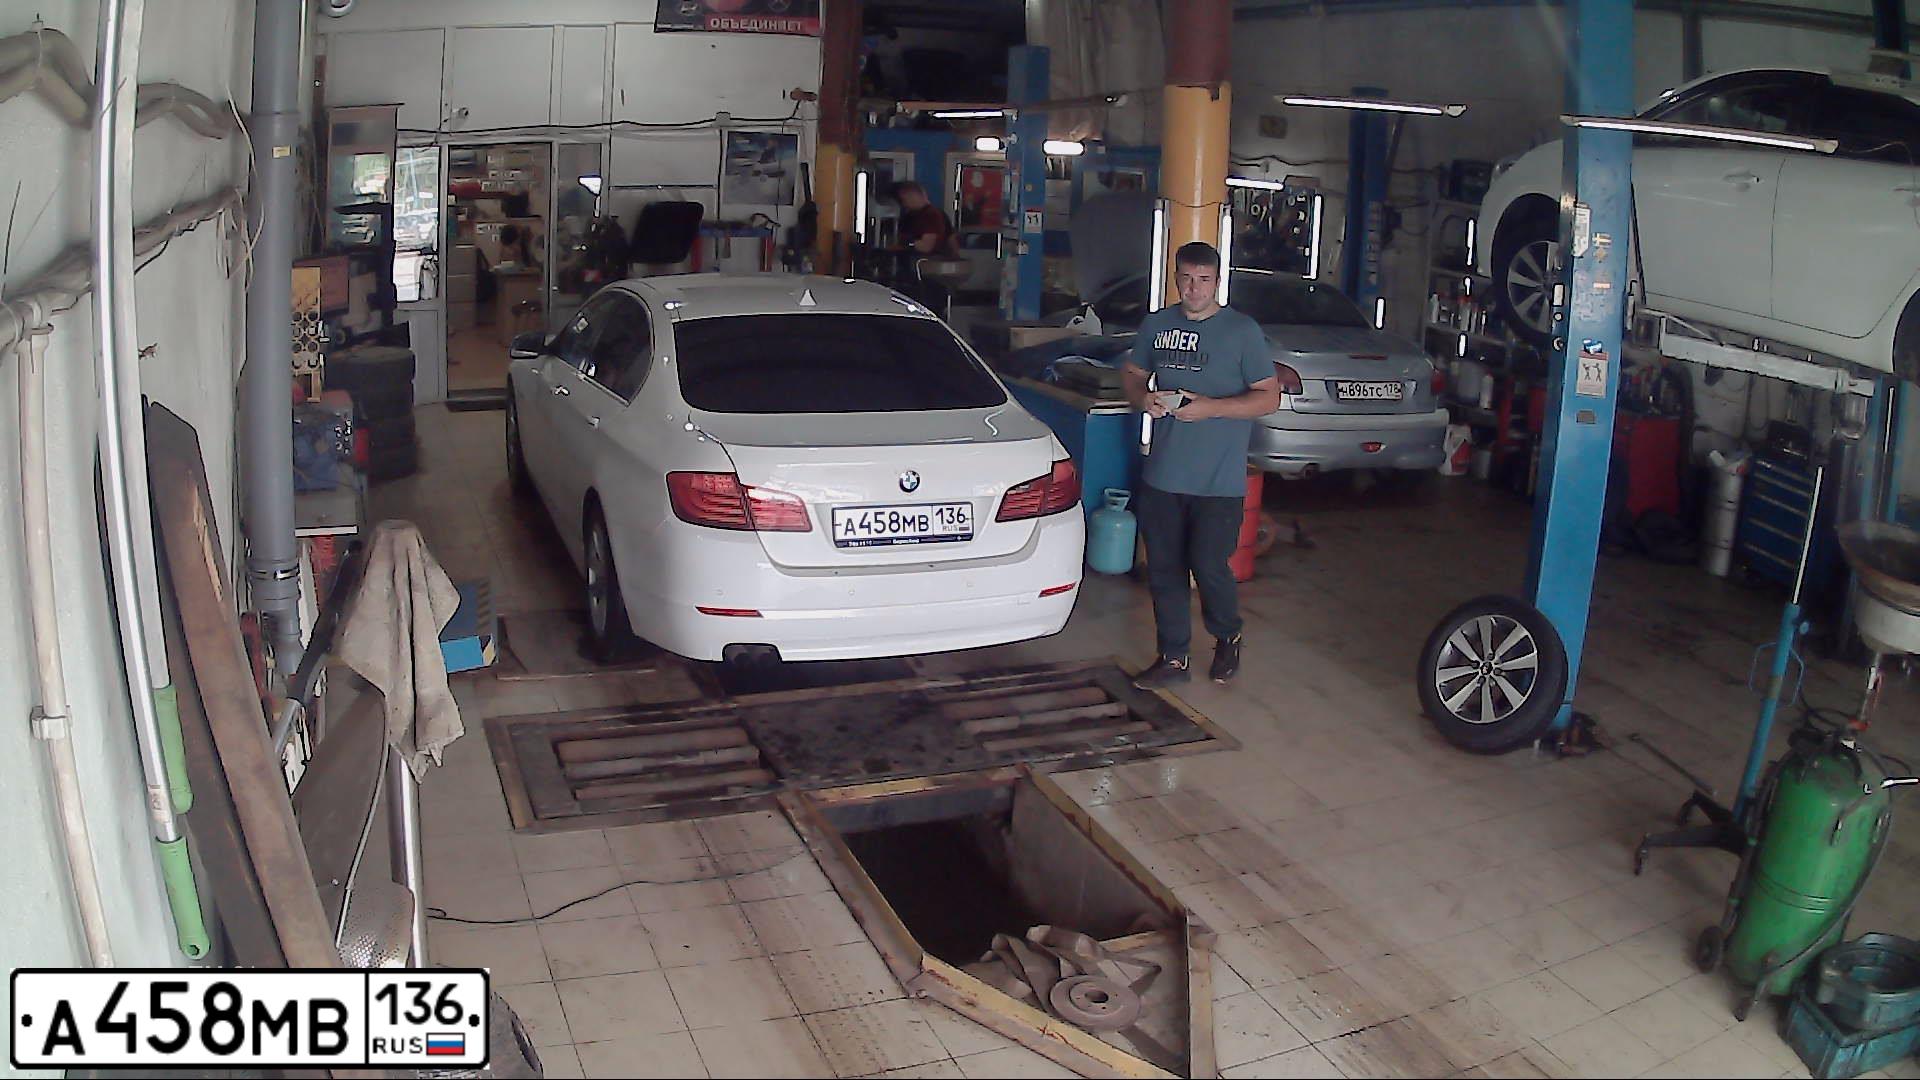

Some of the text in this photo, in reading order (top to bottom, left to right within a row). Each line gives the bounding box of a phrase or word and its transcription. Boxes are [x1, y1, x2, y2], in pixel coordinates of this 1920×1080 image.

[710, 17, 803, 31] ОБЪЕДИНЯЕТ
[1154, 329, 1199, 352] UNDER
[844, 506, 966, 536] А458МВ 136
